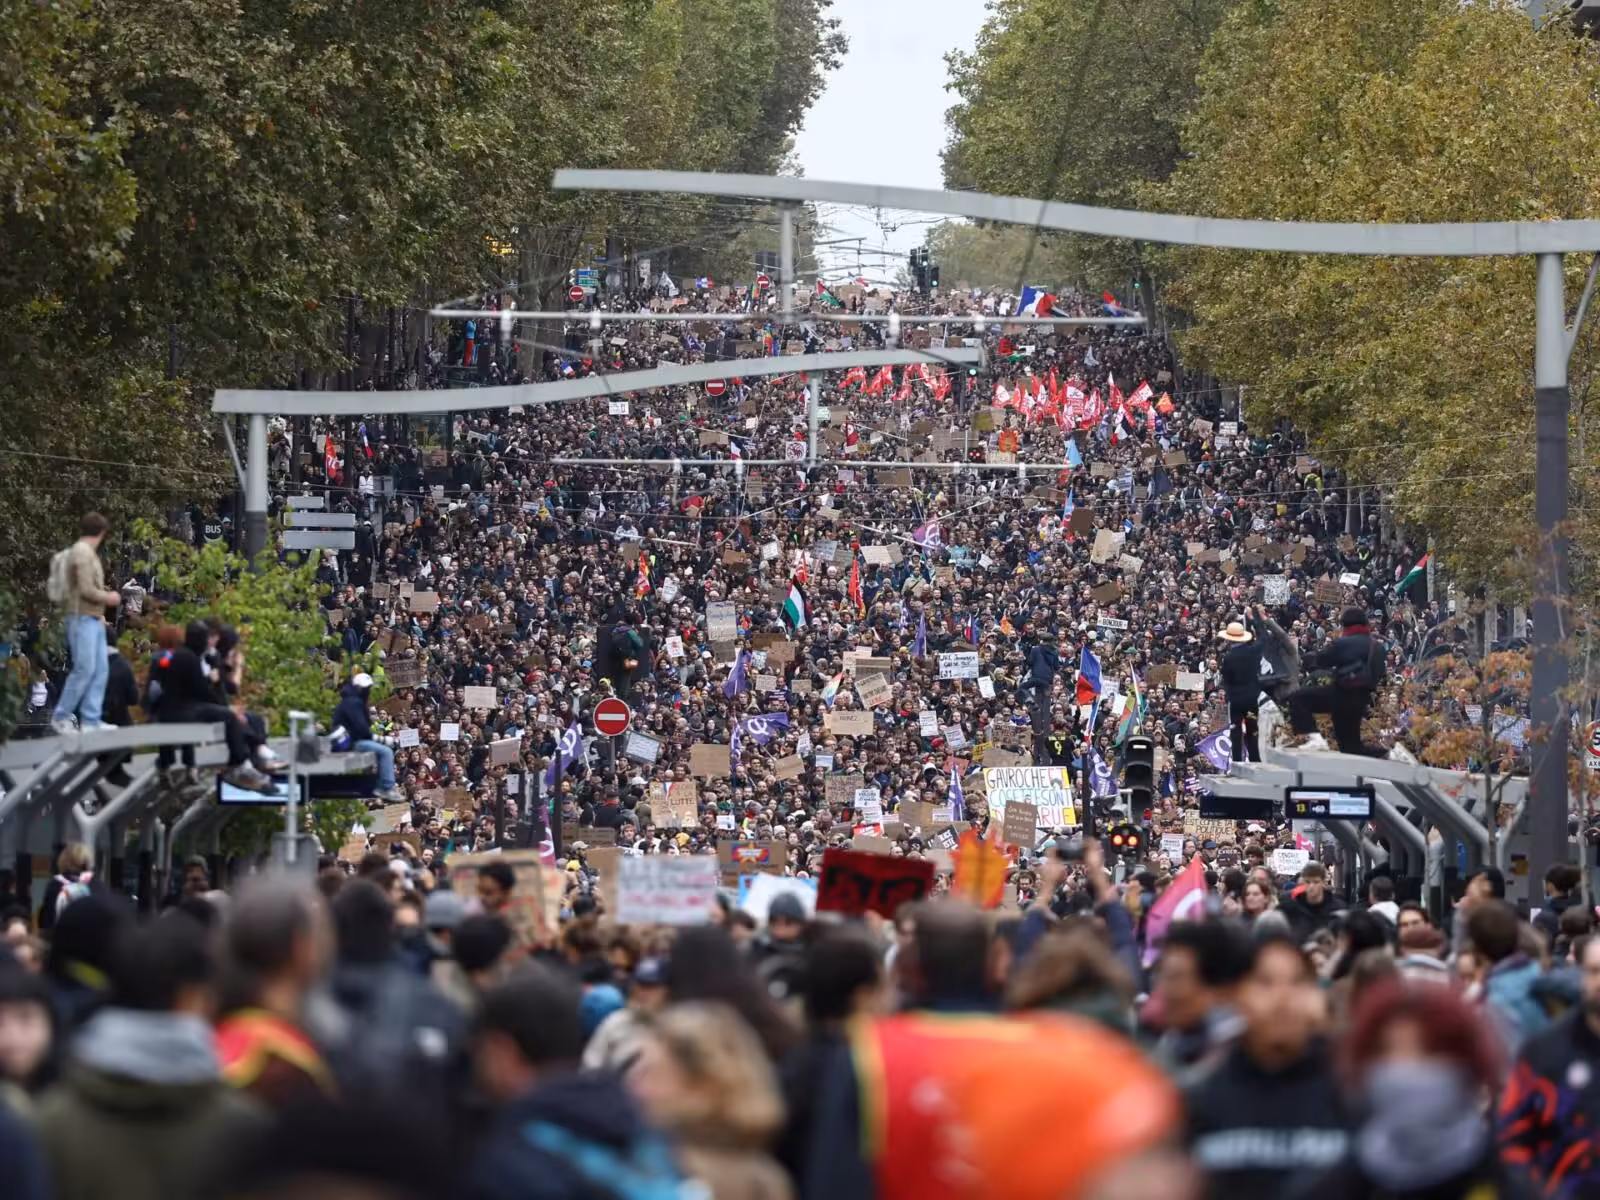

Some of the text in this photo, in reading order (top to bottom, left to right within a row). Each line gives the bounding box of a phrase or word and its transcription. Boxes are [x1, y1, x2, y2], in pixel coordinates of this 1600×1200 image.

[206, 524, 221, 534] BUS
[1055, 741, 1062, 755] 9
[986, 768, 1049, 789] GAVROCHE
[1041, 807, 1075, 826] RUE
